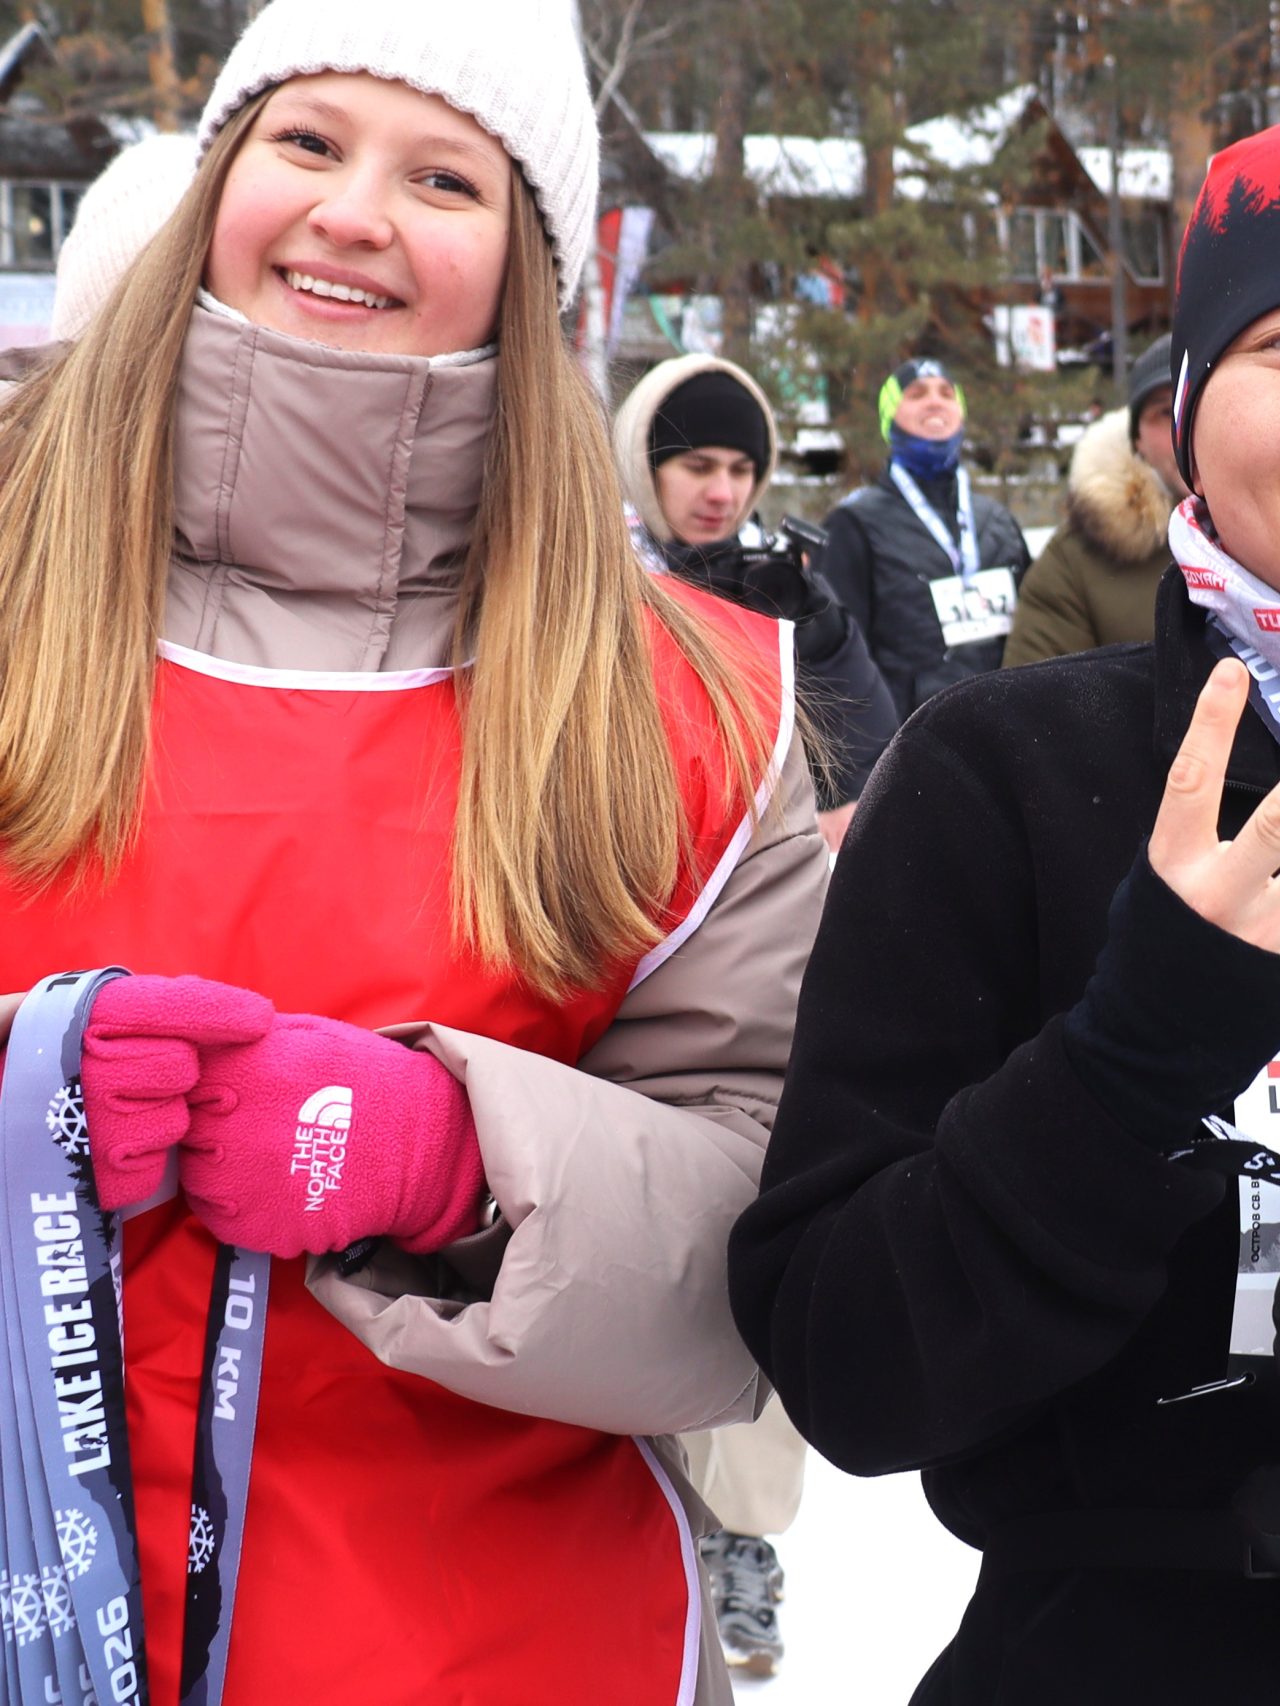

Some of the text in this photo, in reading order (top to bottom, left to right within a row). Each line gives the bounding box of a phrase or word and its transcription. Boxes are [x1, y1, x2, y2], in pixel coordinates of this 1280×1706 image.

[290, 1126, 313, 1175] THE
[304, 1128, 331, 1212] NORTH
[325, 1130, 348, 1190] FACE
[1251, 1213, 1260, 1263] ОСТРОВ
[31, 1191, 112, 1477] LAKE ICE RACE
[214, 1273, 255, 1421] 10 KM
